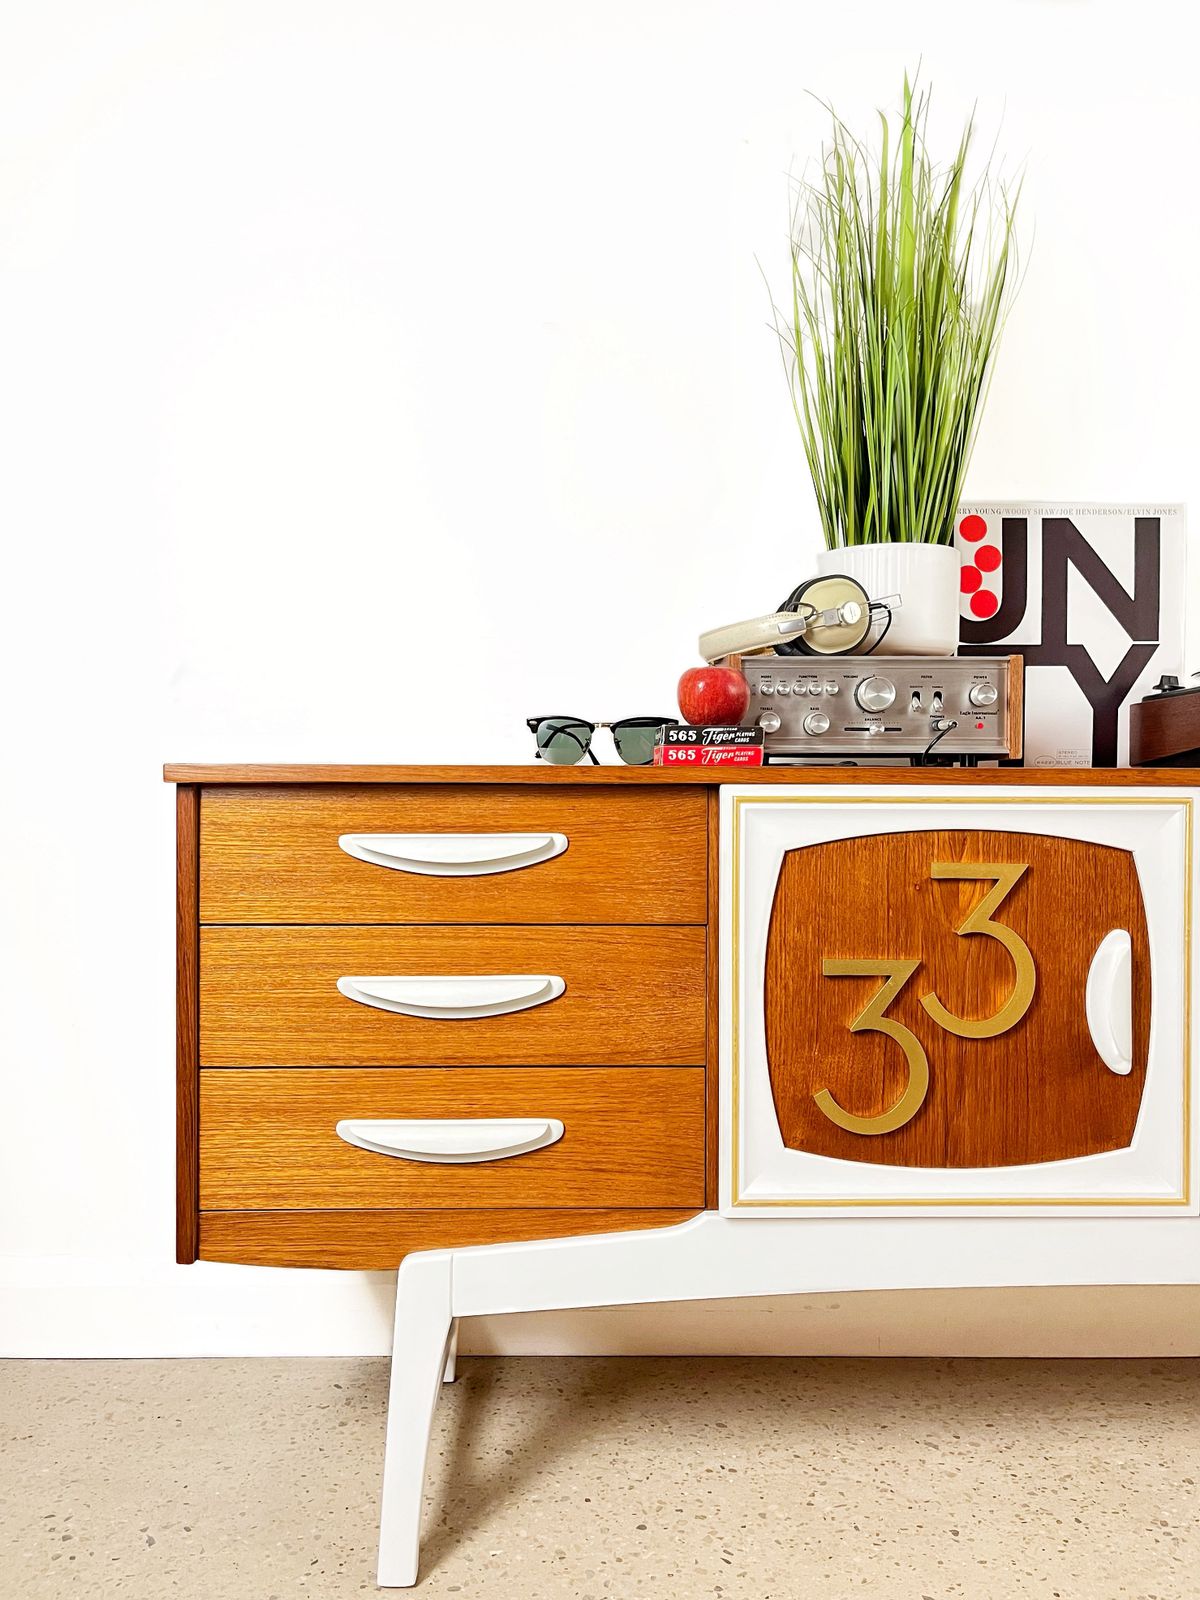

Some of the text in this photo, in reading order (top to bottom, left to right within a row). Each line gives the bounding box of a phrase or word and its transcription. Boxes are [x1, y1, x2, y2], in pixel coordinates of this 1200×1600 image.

[1152, 508, 1177, 516] JONES
[669, 728, 735, 745] 565 Tiger
[668, 747, 735, 764] 565 Tiger
[919, 862, 1036, 1039] 3
[813, 959, 929, 1135] 3
